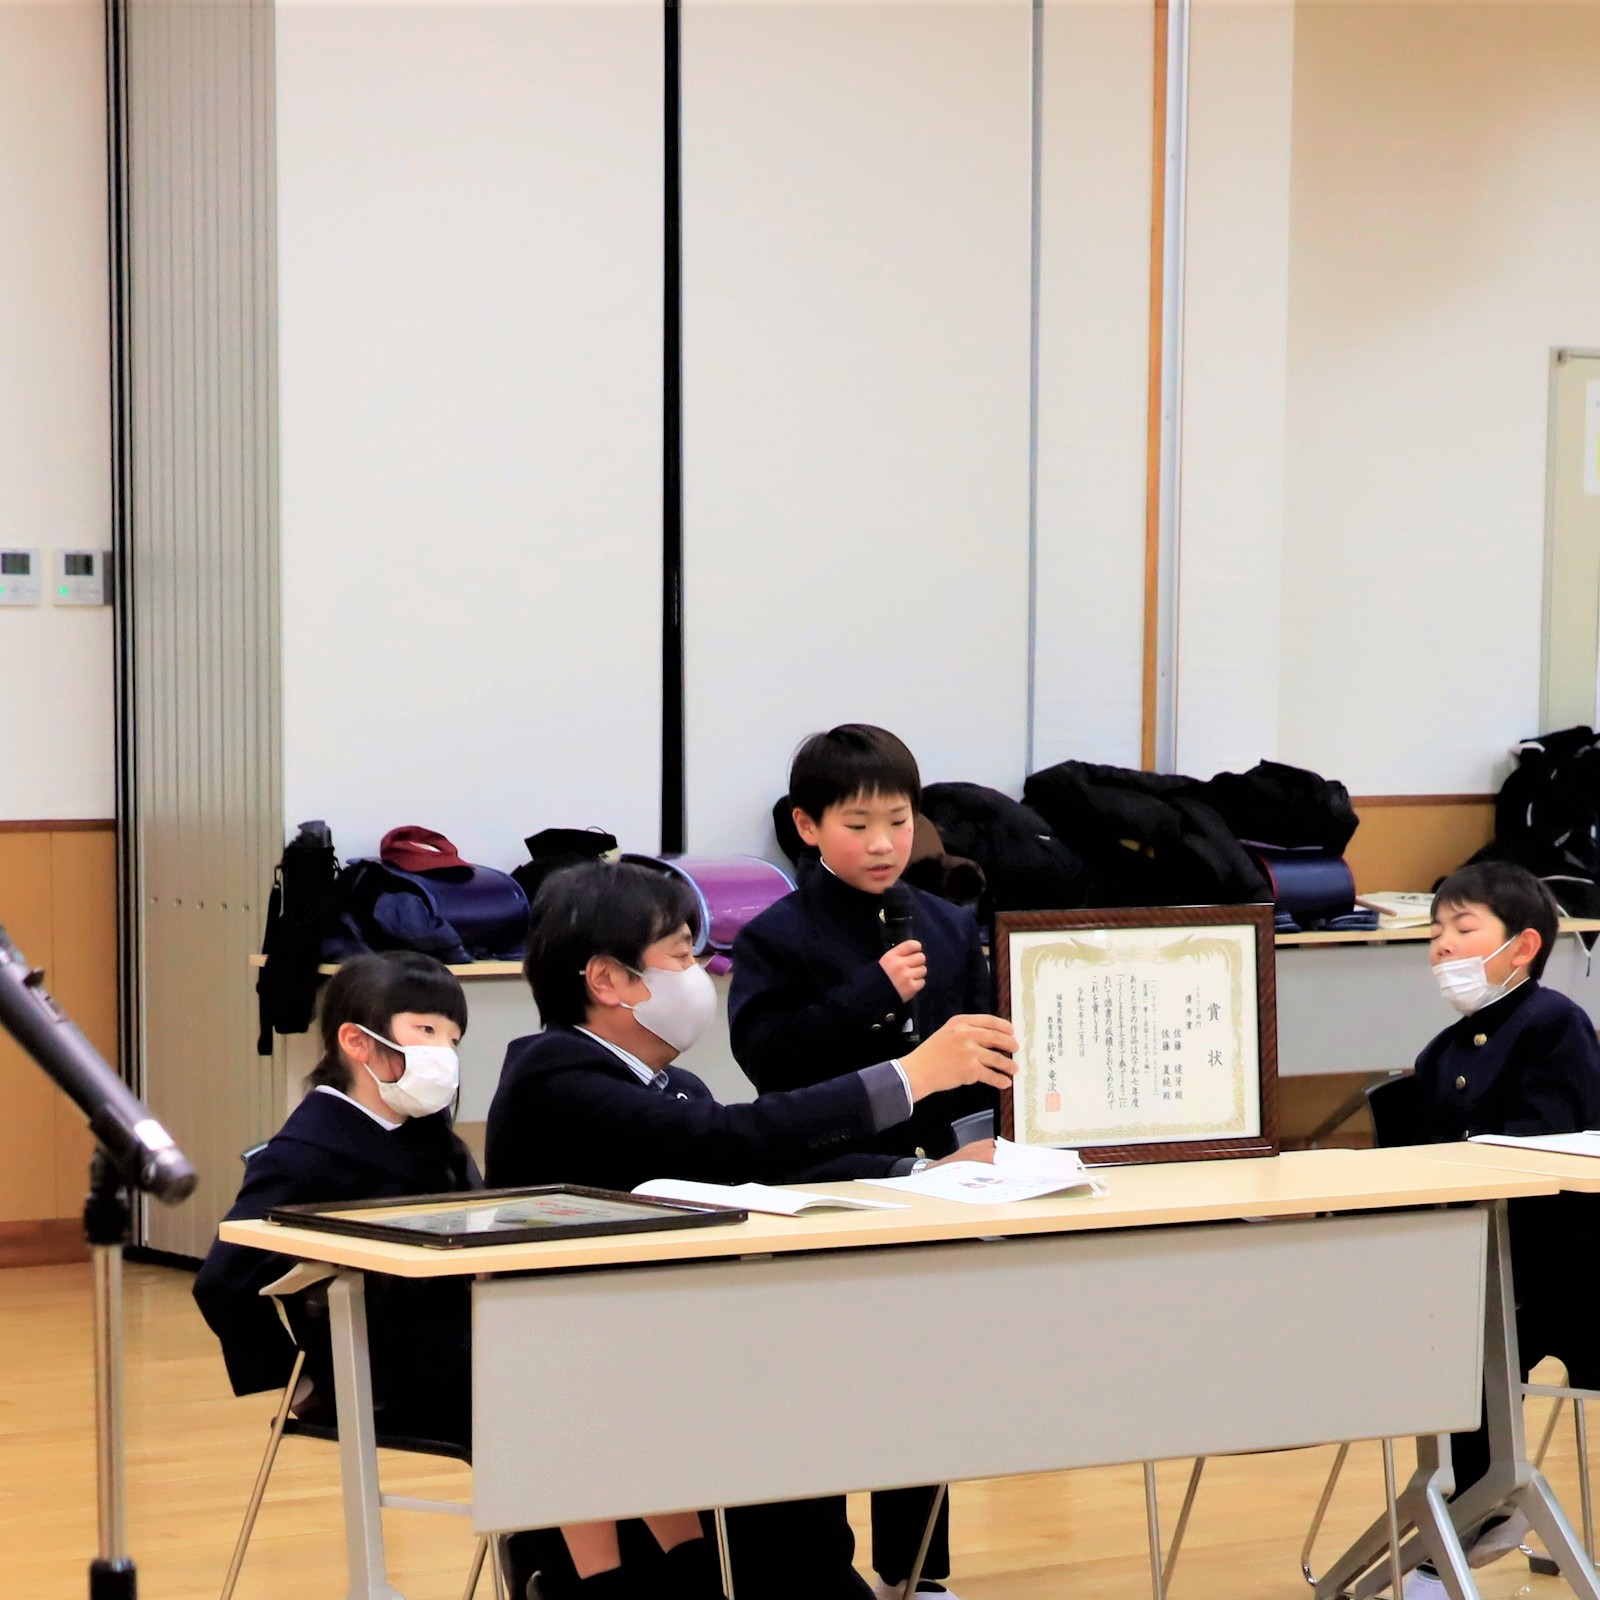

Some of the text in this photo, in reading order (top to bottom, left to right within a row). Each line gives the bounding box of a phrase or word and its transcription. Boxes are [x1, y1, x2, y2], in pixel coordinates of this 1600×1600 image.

[1056, 993, 1064, 1057] 福島県教育委員会
[1092, 975, 1101, 1043] これを賞します
[1130, 975, 1140, 1108] あなた方の作品は令和七年度
[1185, 994, 1193, 1030] 優秀賞
